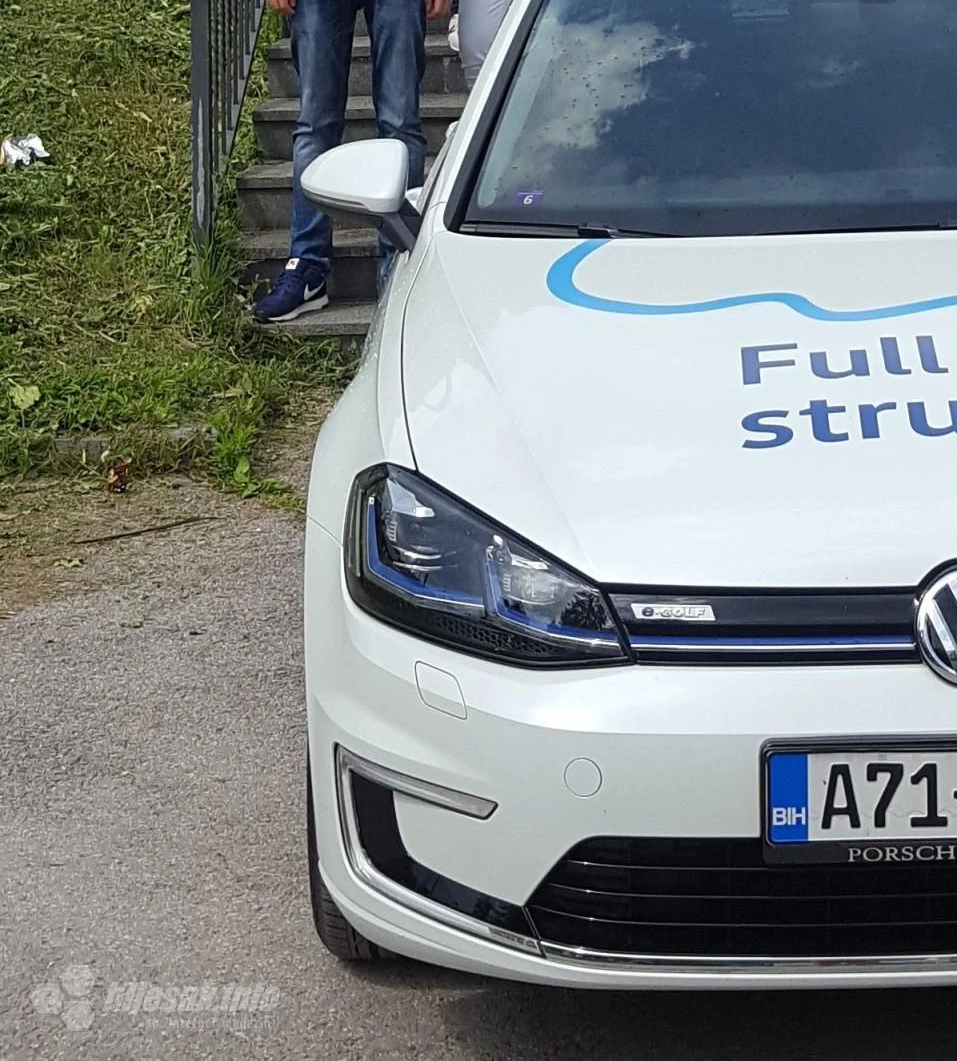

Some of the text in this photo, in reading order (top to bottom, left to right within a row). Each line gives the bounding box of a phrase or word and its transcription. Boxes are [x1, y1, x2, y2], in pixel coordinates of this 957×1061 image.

[523, 194, 534, 205] 6
[741, 335, 949, 386] Full
[772, 807, 806, 826] BIH
